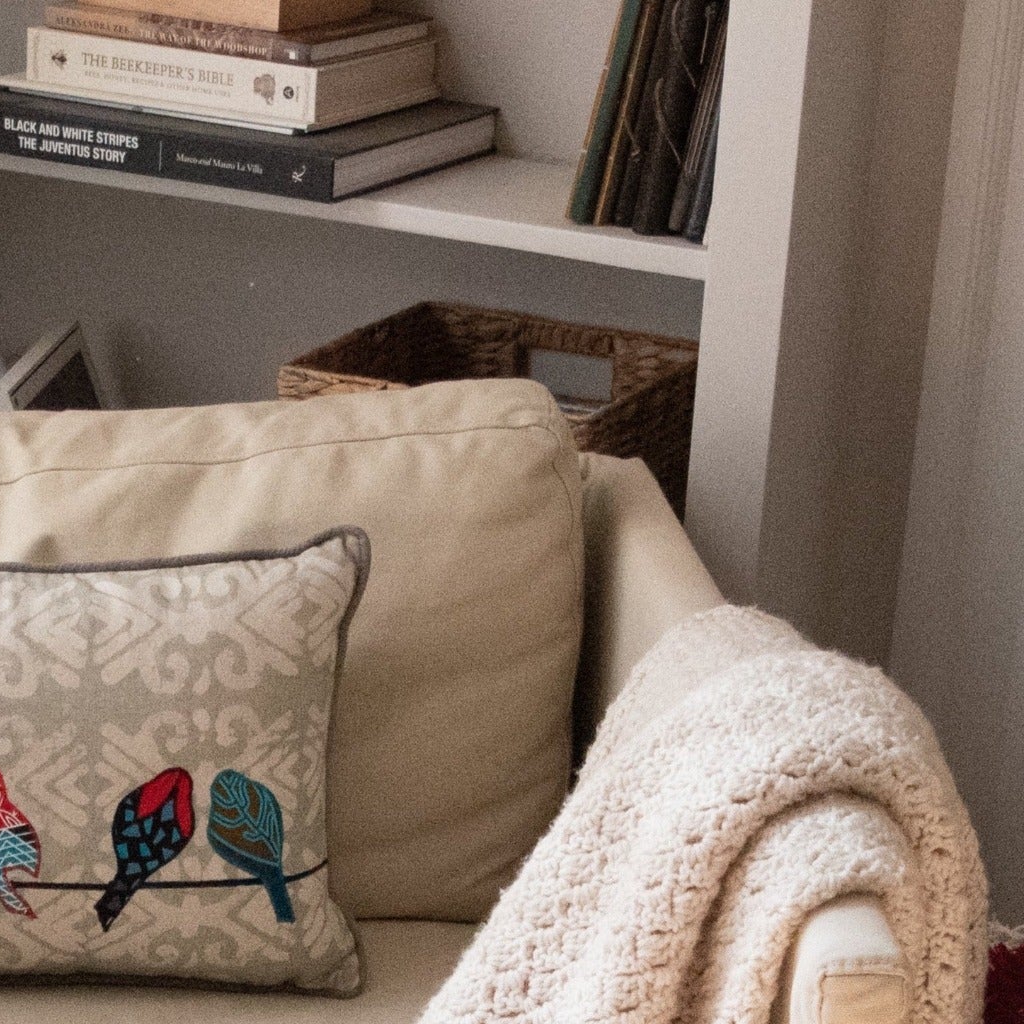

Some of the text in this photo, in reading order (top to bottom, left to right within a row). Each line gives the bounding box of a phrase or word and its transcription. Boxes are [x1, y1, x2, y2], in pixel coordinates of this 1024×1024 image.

[139, 28, 156, 40] THE
[159, 31, 179, 43] WAY
[195, 37, 213, 48] THE
[81, 52, 235, 87] THE BEEKEEPER'S BIBLE
[4, 117, 139, 149] BLACK AND WHITE STRIPES
[18, 136, 126, 164] THE JUVENTUS STORY
[176, 153, 197, 165] Marco
[213, 159, 235, 170] Mauro
[237, 162, 246, 172] La
[246, 163, 263, 175] Villa
